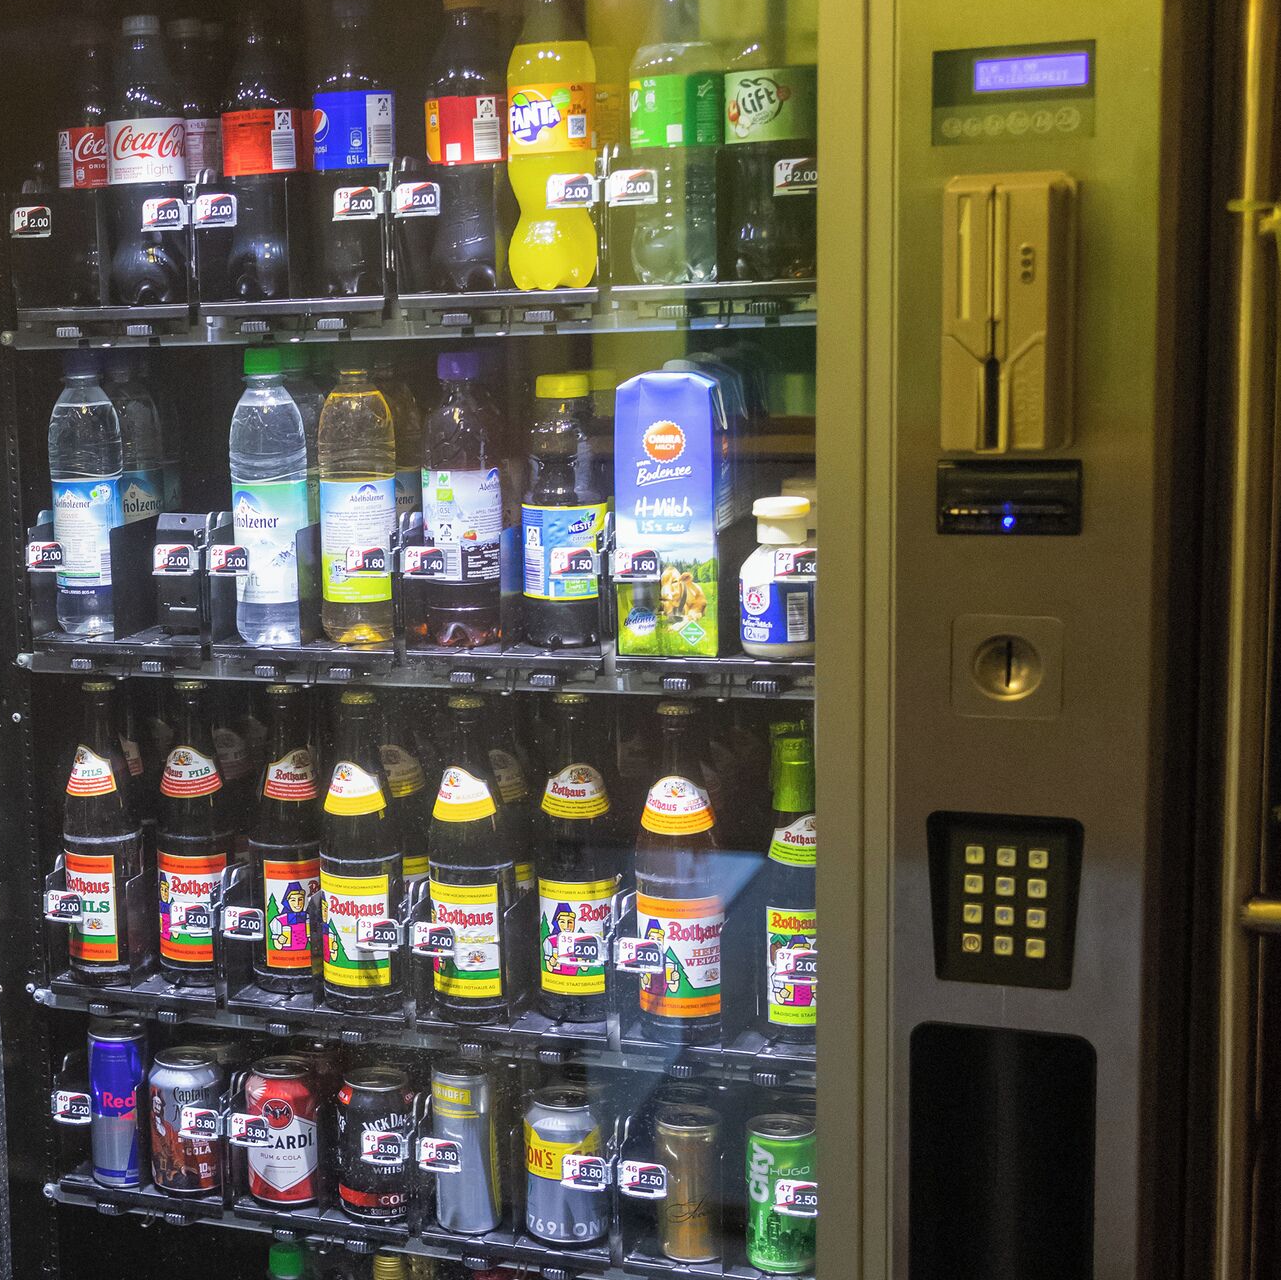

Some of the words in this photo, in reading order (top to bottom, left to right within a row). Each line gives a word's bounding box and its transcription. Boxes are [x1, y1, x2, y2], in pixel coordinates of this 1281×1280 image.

[146, 162, 174, 177] light
[794, 171, 817, 181] 2.00
[565, 187, 588, 198] 2.00
[627, 182, 650, 193] 2.00
[413, 194, 434, 205] 2.00
[351, 200, 372, 210] 2.00
[158, 210, 178, 220] 2.00
[212, 205, 231, 216] 2.00
[30, 218, 48, 228] 2.00
[636, 464, 692, 487] Bodensee
[634, 496, 693, 518] H-Milch
[43, 551, 61, 560] 2.00
[169, 557, 188, 566] 2.00
[227, 558, 246, 567] 2.00
[364, 559, 384, 568] 1.60
[422, 560, 442, 569] 1.40
[570, 560, 592, 570] 1.50
[633, 560, 654, 570] 1.60
[189, 767, 210, 778] PILS
[61, 902, 78, 911] 2.00
[82, 900, 111, 913] ILS
[329, 896, 384, 920] Rothaus
[188, 914, 208, 924] 2.00
[438, 904, 494, 928] Rothaus
[240, 920, 259, 930] 2.00
[375, 930, 395, 940] 2.00
[432, 936, 452, 946] 2.00
[575, 946, 596, 955] 2.00
[636, 951, 658, 961] 2.00
[685, 958, 720, 969] WEIZE
[102, 1090, 136, 1108] Red
[71, 1105, 89, 1115] 2.20
[196, 1119, 215, 1129] 3.80
[247, 1127, 266, 1138] 3.80
[186, 1145, 212, 1156] COLA
[379, 1144, 398, 1154] 3.80
[282, 1153, 302, 1161] COLA
[436, 1150, 456, 1161] 3.80
[581, 1167, 601, 1178] 3.80
[770, 1166, 810, 1177] HUGO
[641, 1175, 662, 1185] 2.50
[795, 1195, 817, 1205] 2.50
